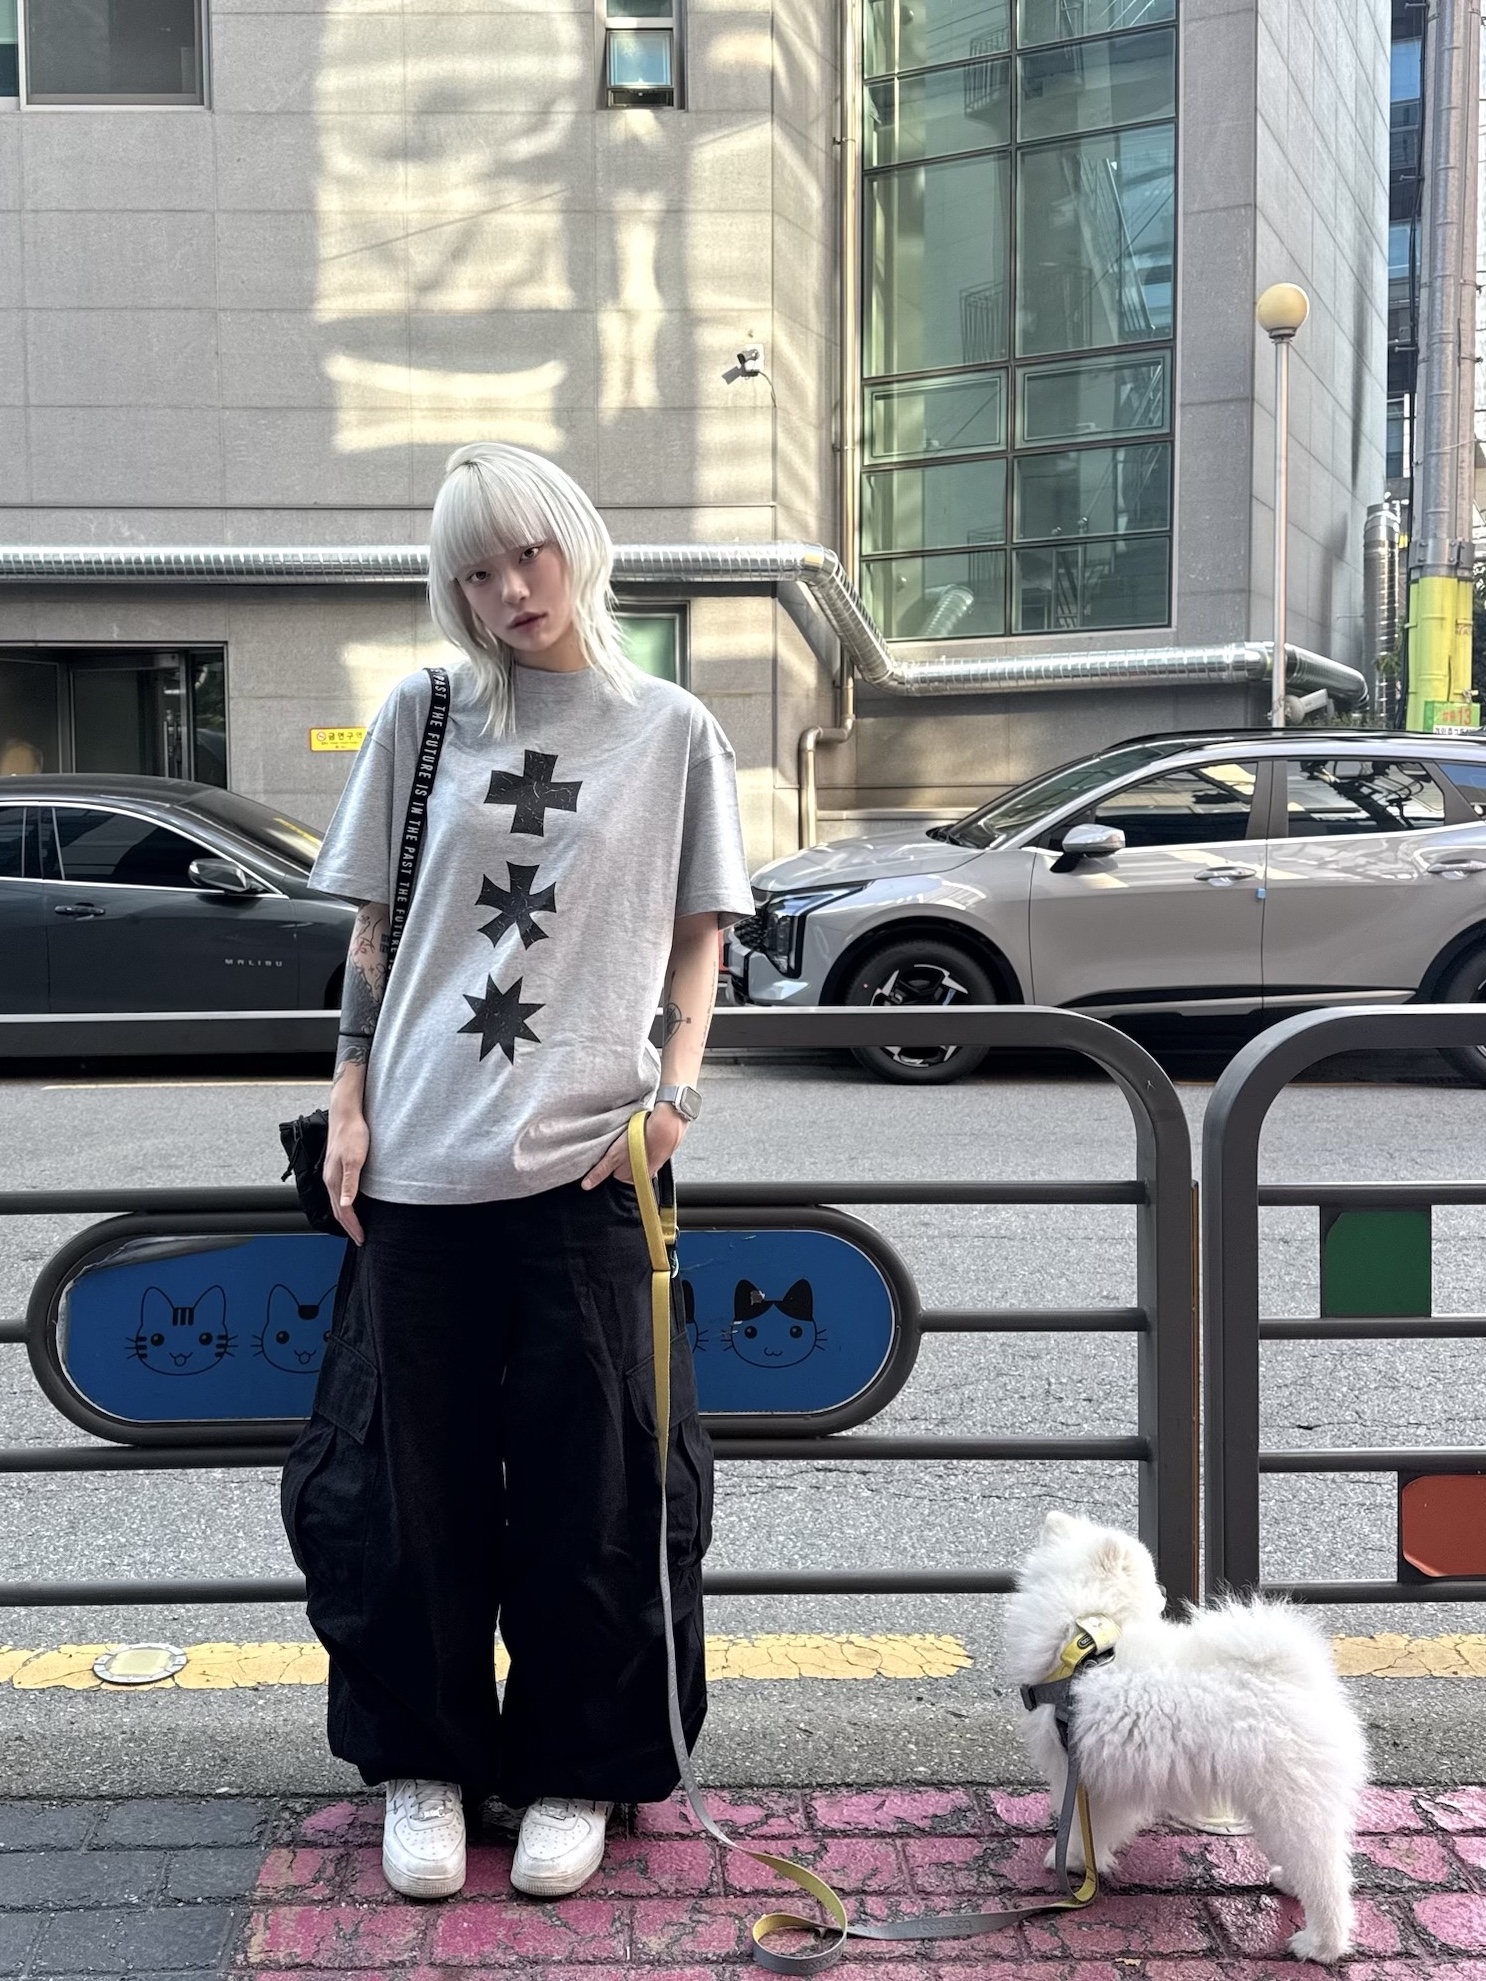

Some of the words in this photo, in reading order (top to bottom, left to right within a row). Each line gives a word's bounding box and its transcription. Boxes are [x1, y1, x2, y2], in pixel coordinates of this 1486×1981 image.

[433, 675, 447, 699] PAST
[430, 706, 446, 727] THE
[419, 732, 440, 779] FUTURE
[415, 783, 429, 797] IS
[411, 801, 424, 815] IN
[405, 820, 421, 841] THE
[401, 846, 416, 875] PAST
[397, 882, 410, 902] THE
[391, 909, 405, 953] FUTURE
[224, 958, 283, 967] MALIBU
